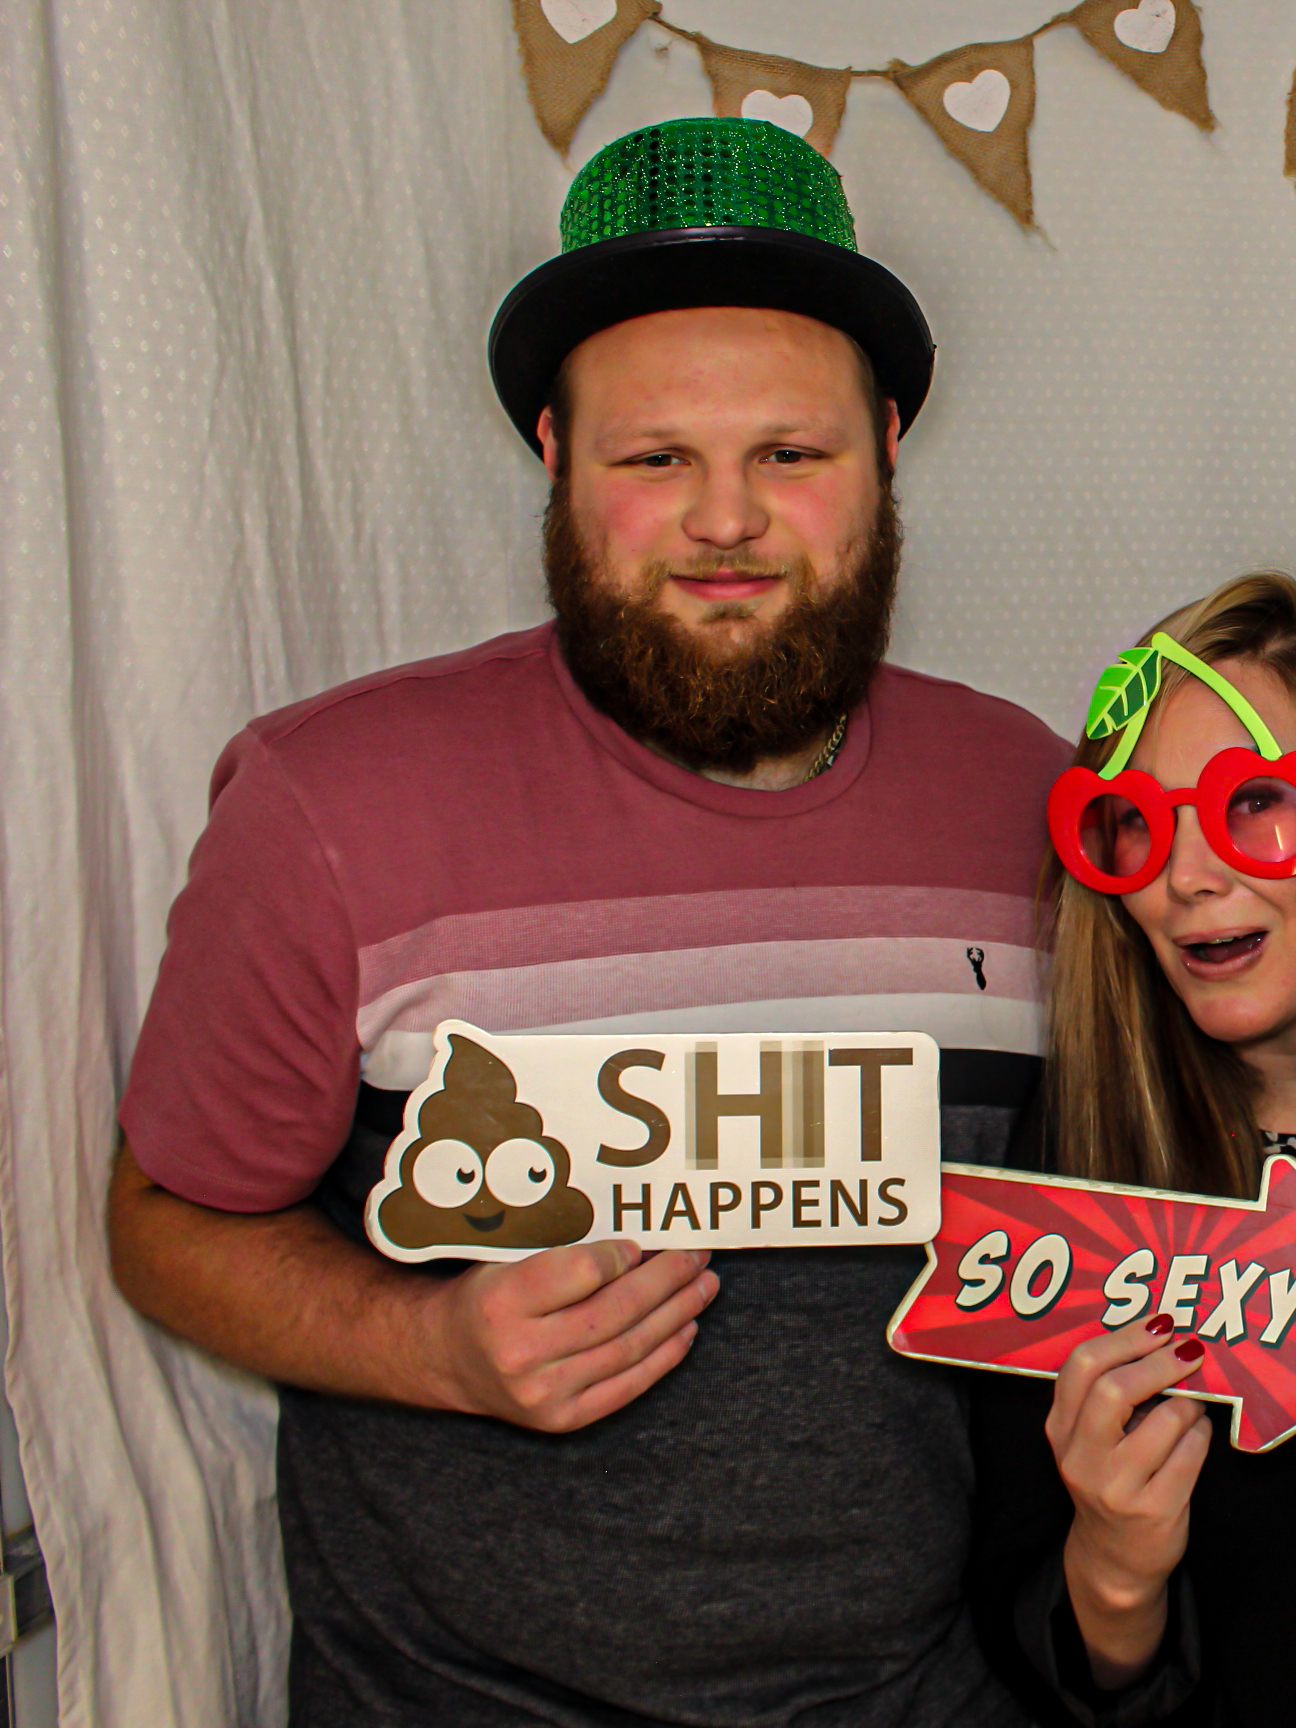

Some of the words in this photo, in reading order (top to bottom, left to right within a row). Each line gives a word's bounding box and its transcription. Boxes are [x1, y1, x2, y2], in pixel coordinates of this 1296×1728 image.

[596, 1041, 914, 1170] SHIT
[611, 1178, 909, 1232] HAPPENS
[955, 1230, 1073, 1320] SO
